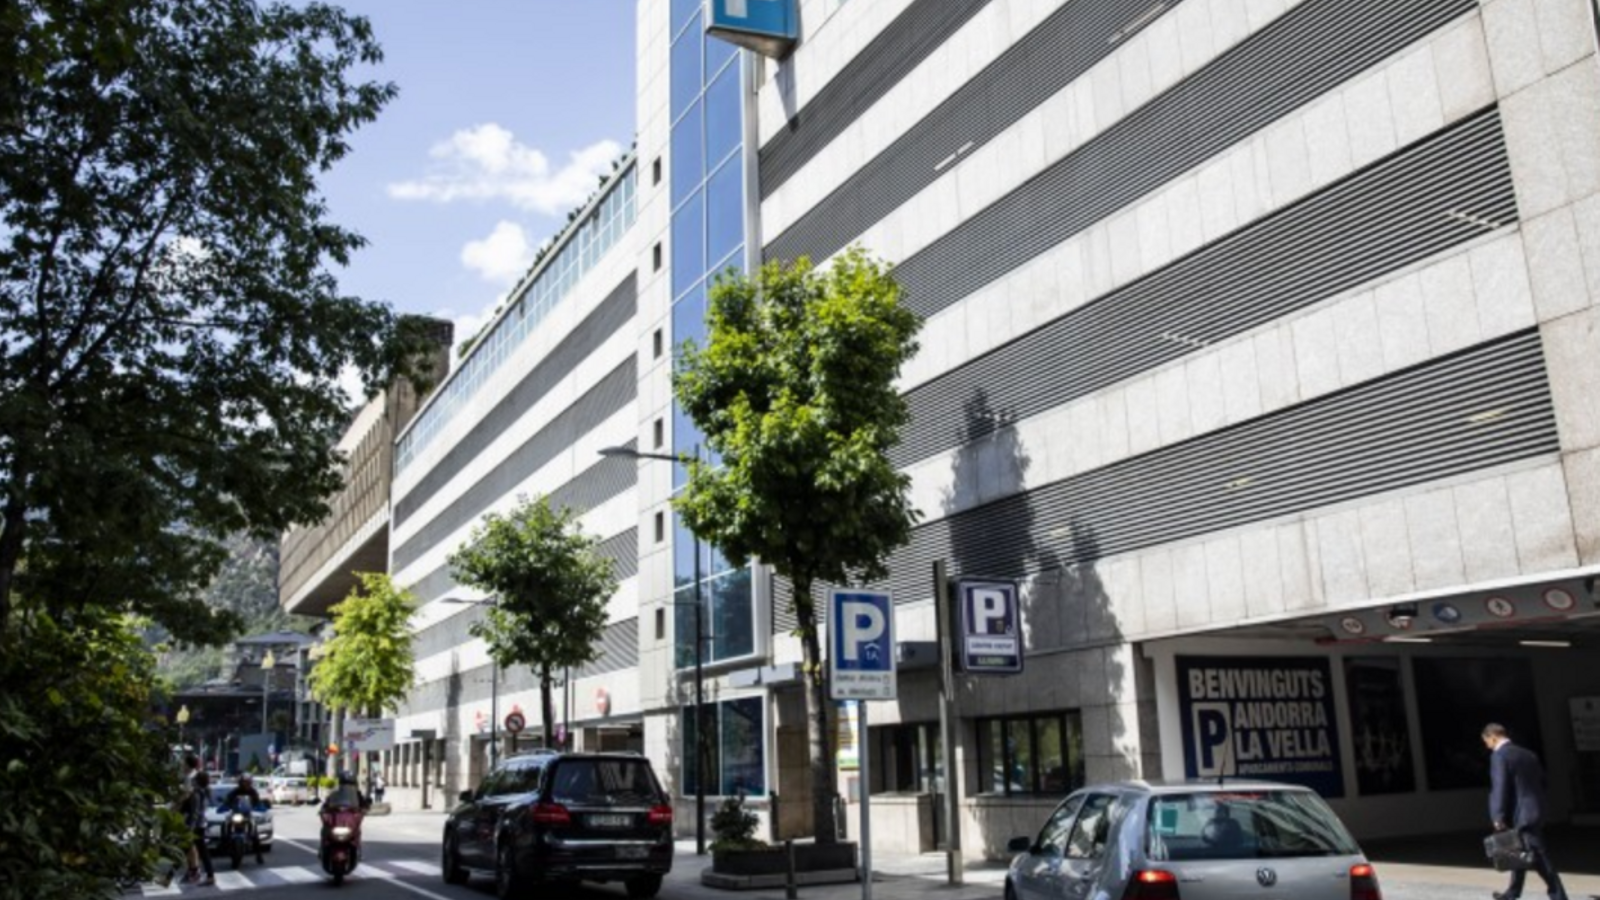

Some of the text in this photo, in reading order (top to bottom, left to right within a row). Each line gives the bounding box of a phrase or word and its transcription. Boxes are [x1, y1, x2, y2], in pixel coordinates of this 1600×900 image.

[972, 588, 1006, 634] P
[841, 601, 885, 661] P
[1188, 667, 1326, 700] BENVINGUTS
[1234, 701, 1328, 729] ANDORRA
[1198, 709, 1228, 770] P
[1234, 729, 1331, 760] LA VELLA
